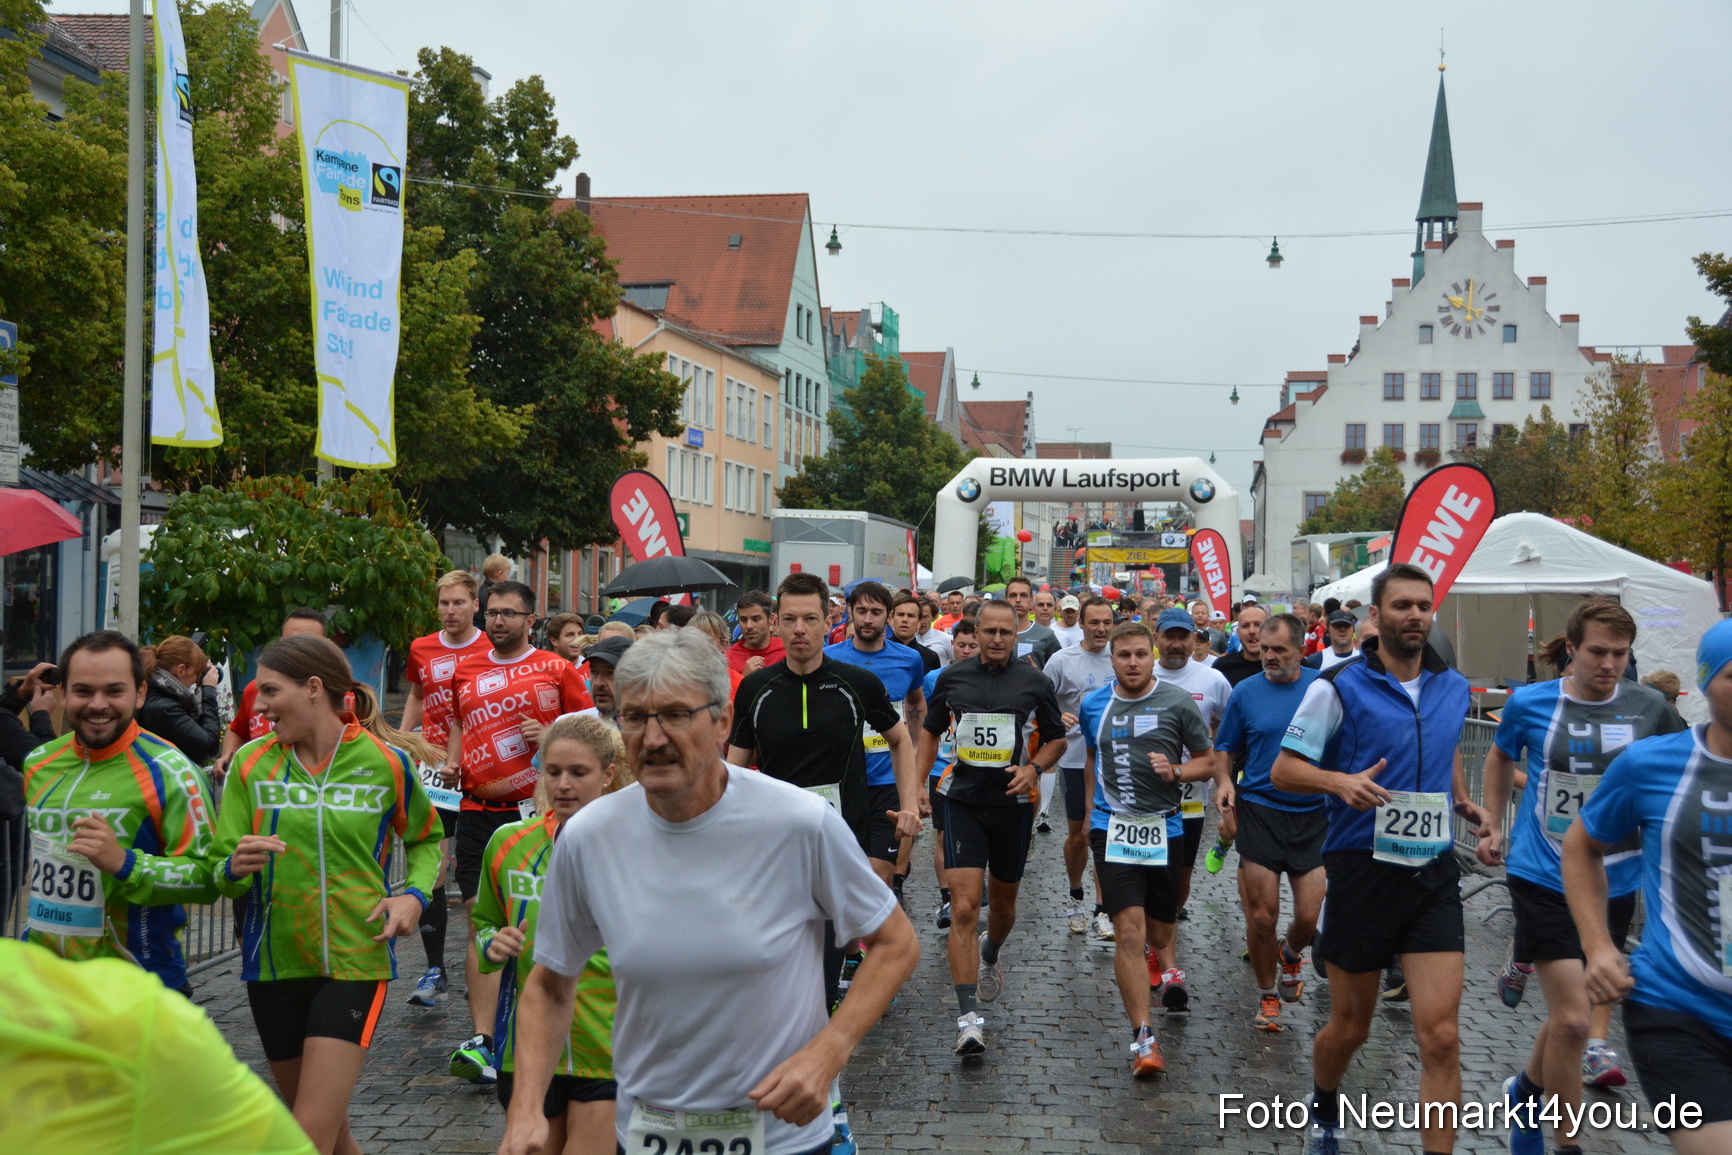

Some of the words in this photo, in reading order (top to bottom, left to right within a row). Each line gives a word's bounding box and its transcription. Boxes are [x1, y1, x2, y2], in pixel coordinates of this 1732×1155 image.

[990, 467, 1056, 488] BMW
[1062, 468, 1181, 492] Laufsport
[1408, 484, 1481, 585] EWE
[1126, 551, 1150, 561] ZIEL
[509, 659, 570, 680] raum
[872, 738, 888, 746] Pete
[974, 726, 998, 747] 55
[968, 750, 1002, 761] Matthias
[1111, 715, 1137, 806] HIMATEC
[255, 780, 392, 814] BOCK
[427, 790, 450, 802] Oliver
[1384, 808, 1443, 838] 2281
[1113, 822, 1162, 846] 2098
[1122, 847, 1152, 858] Markus
[1391, 842, 1436, 857] Bernhard
[31, 858, 96, 902] 2836
[37, 903, 73, 923] Darius
[684, 1109, 753, 1128] BOCK
